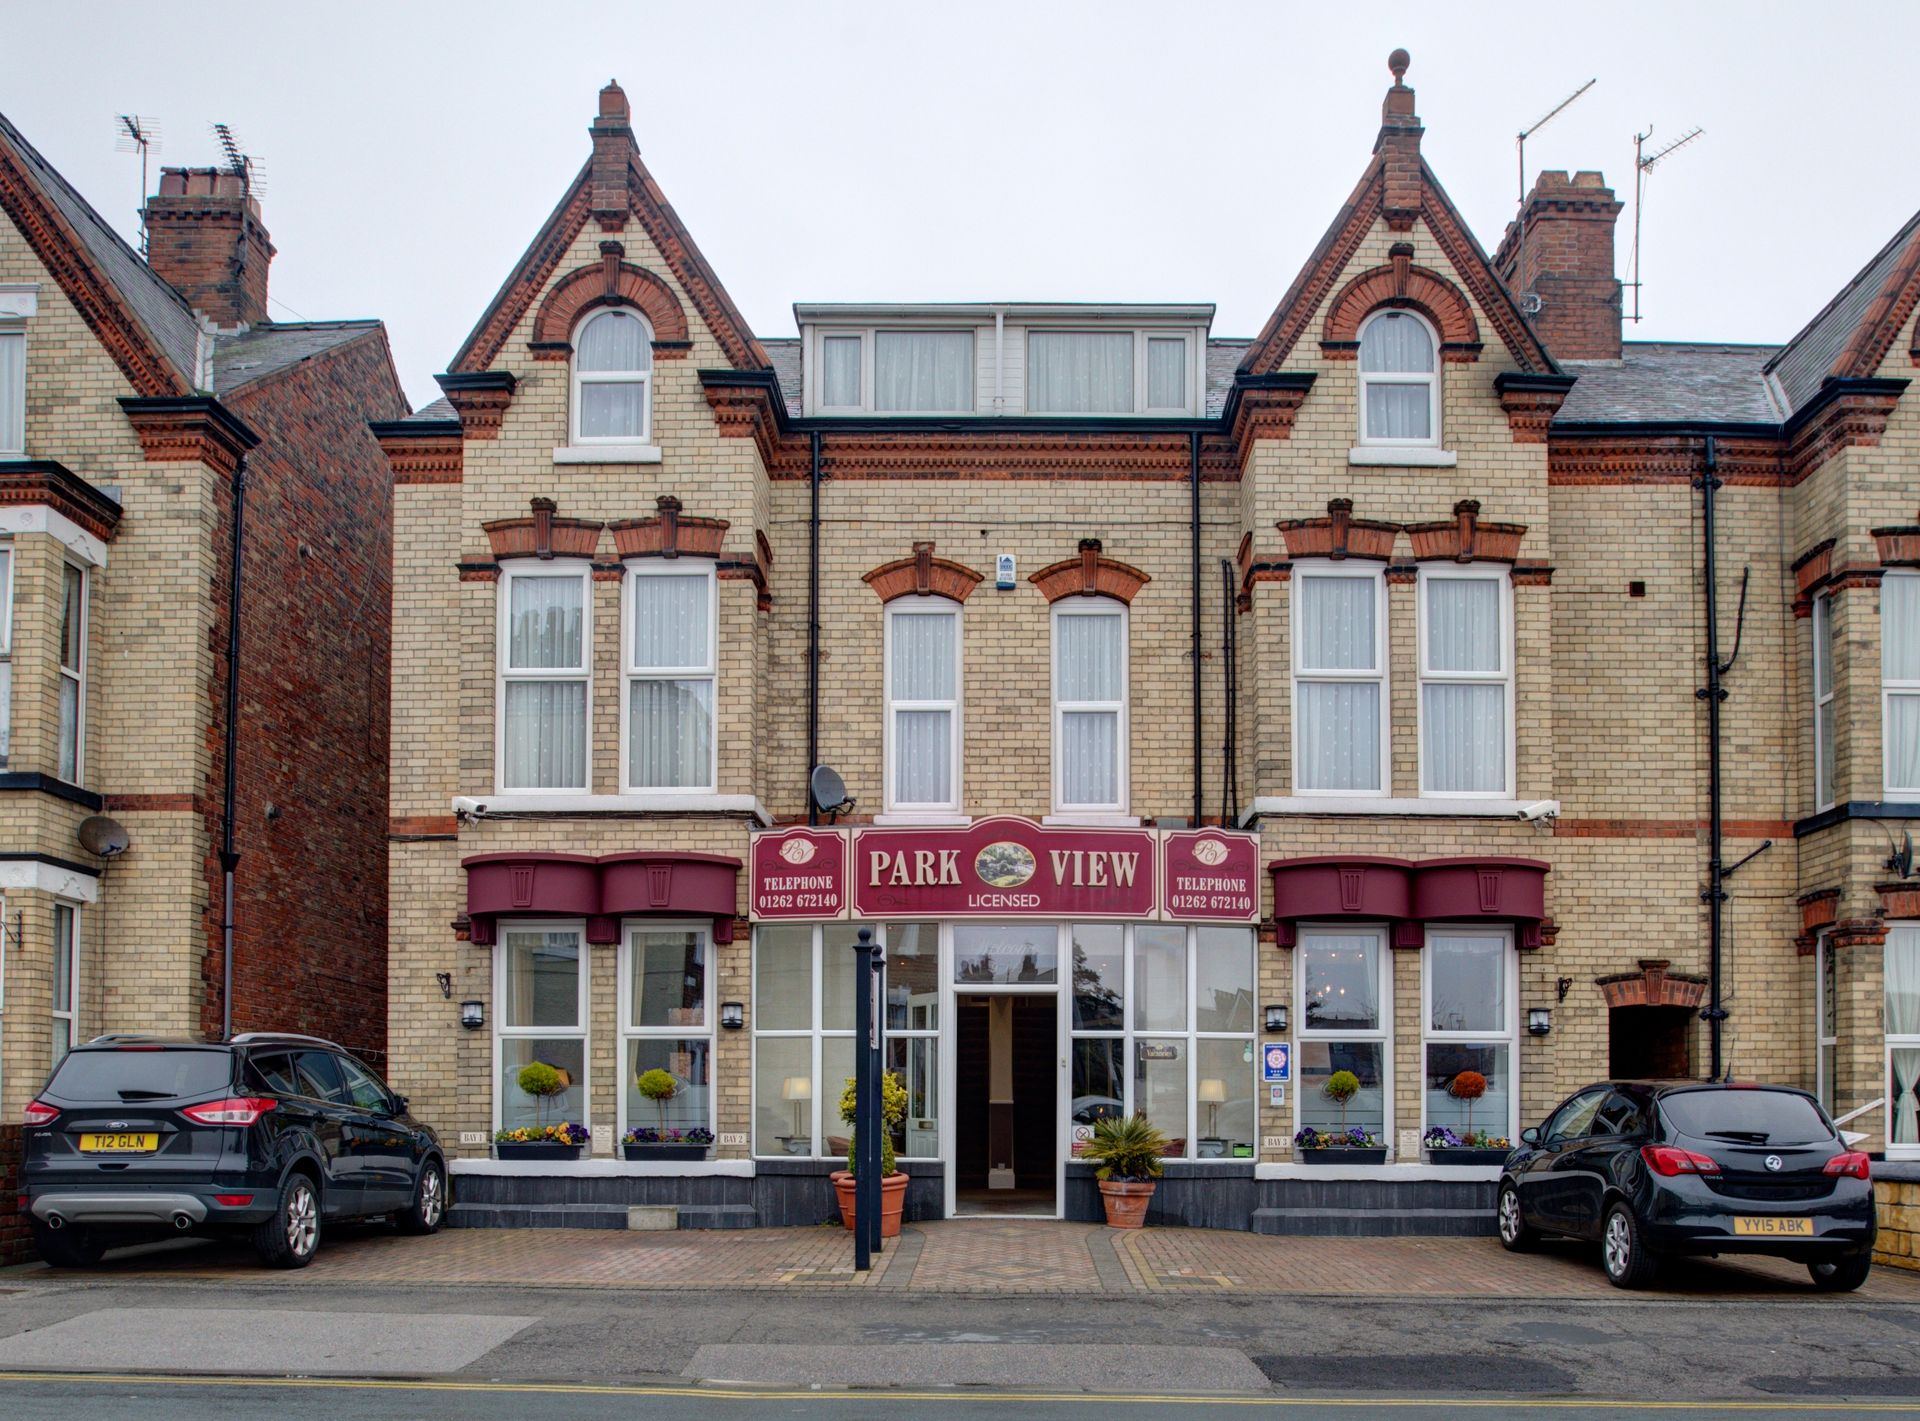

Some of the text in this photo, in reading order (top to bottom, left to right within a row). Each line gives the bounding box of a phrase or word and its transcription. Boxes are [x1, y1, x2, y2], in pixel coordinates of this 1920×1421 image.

[868, 849, 1141, 888] PARK VIEW
[763, 875, 834, 891] TELEPHONE
[1176, 876, 1247, 893] TELEPHONE
[759, 893, 838, 908] 01262 672140
[967, 894, 1041, 908] LICENSED
[1172, 894, 1252, 910] 01262 672140
[94, 1135, 145, 1148] T12 GLN
[723, 1135, 743, 1144] BAY 2
[1267, 1138, 1281, 1146] BAY
[1743, 1219, 1805, 1233] YY15 ABK
